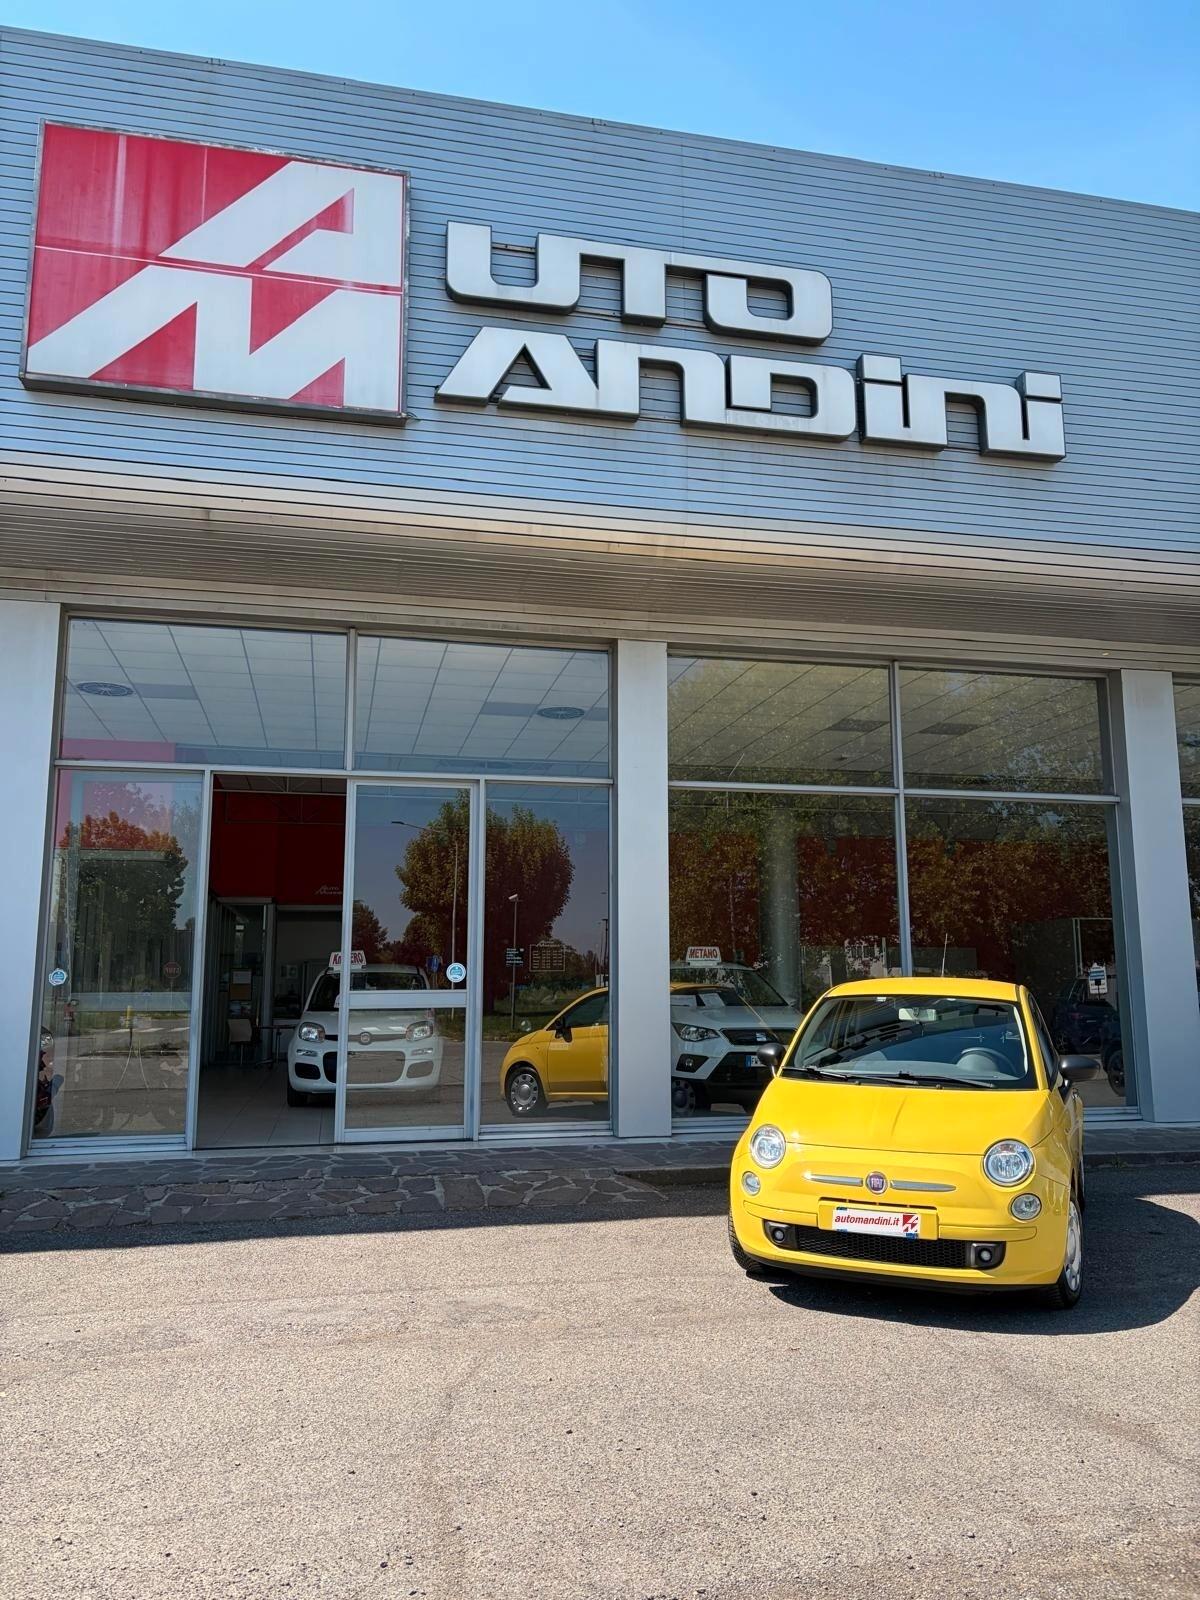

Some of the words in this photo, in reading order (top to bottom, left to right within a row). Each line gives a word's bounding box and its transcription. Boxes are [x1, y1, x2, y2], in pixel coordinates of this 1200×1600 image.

[446, 220, 833, 346] UTO
[689, 948, 718, 959] METANO
[835, 1214, 900, 1226] automandini.it
